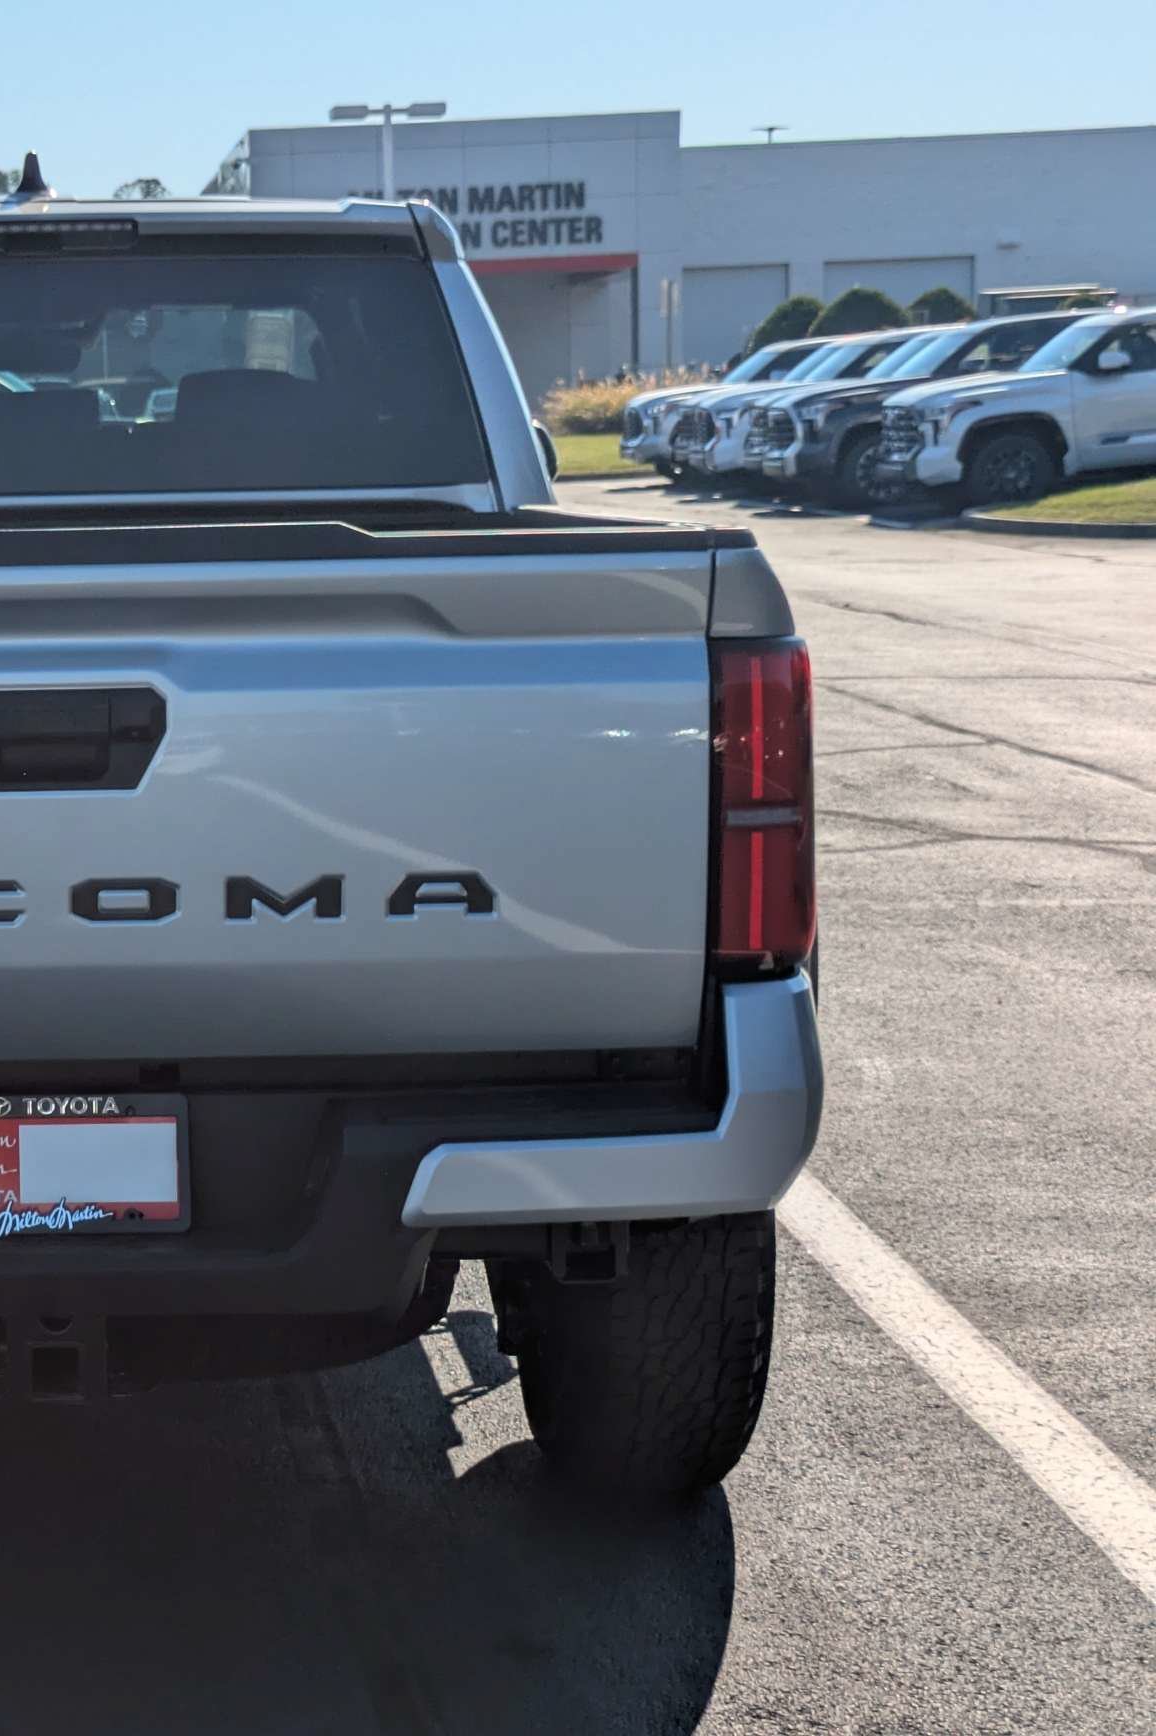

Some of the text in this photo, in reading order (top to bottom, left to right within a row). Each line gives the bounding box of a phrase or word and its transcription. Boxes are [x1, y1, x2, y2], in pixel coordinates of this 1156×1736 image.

[467, 181, 586, 215] MARTIN
[490, 216, 603, 248] CENTER
[22, 1097, 120, 1116] TOYOTA
